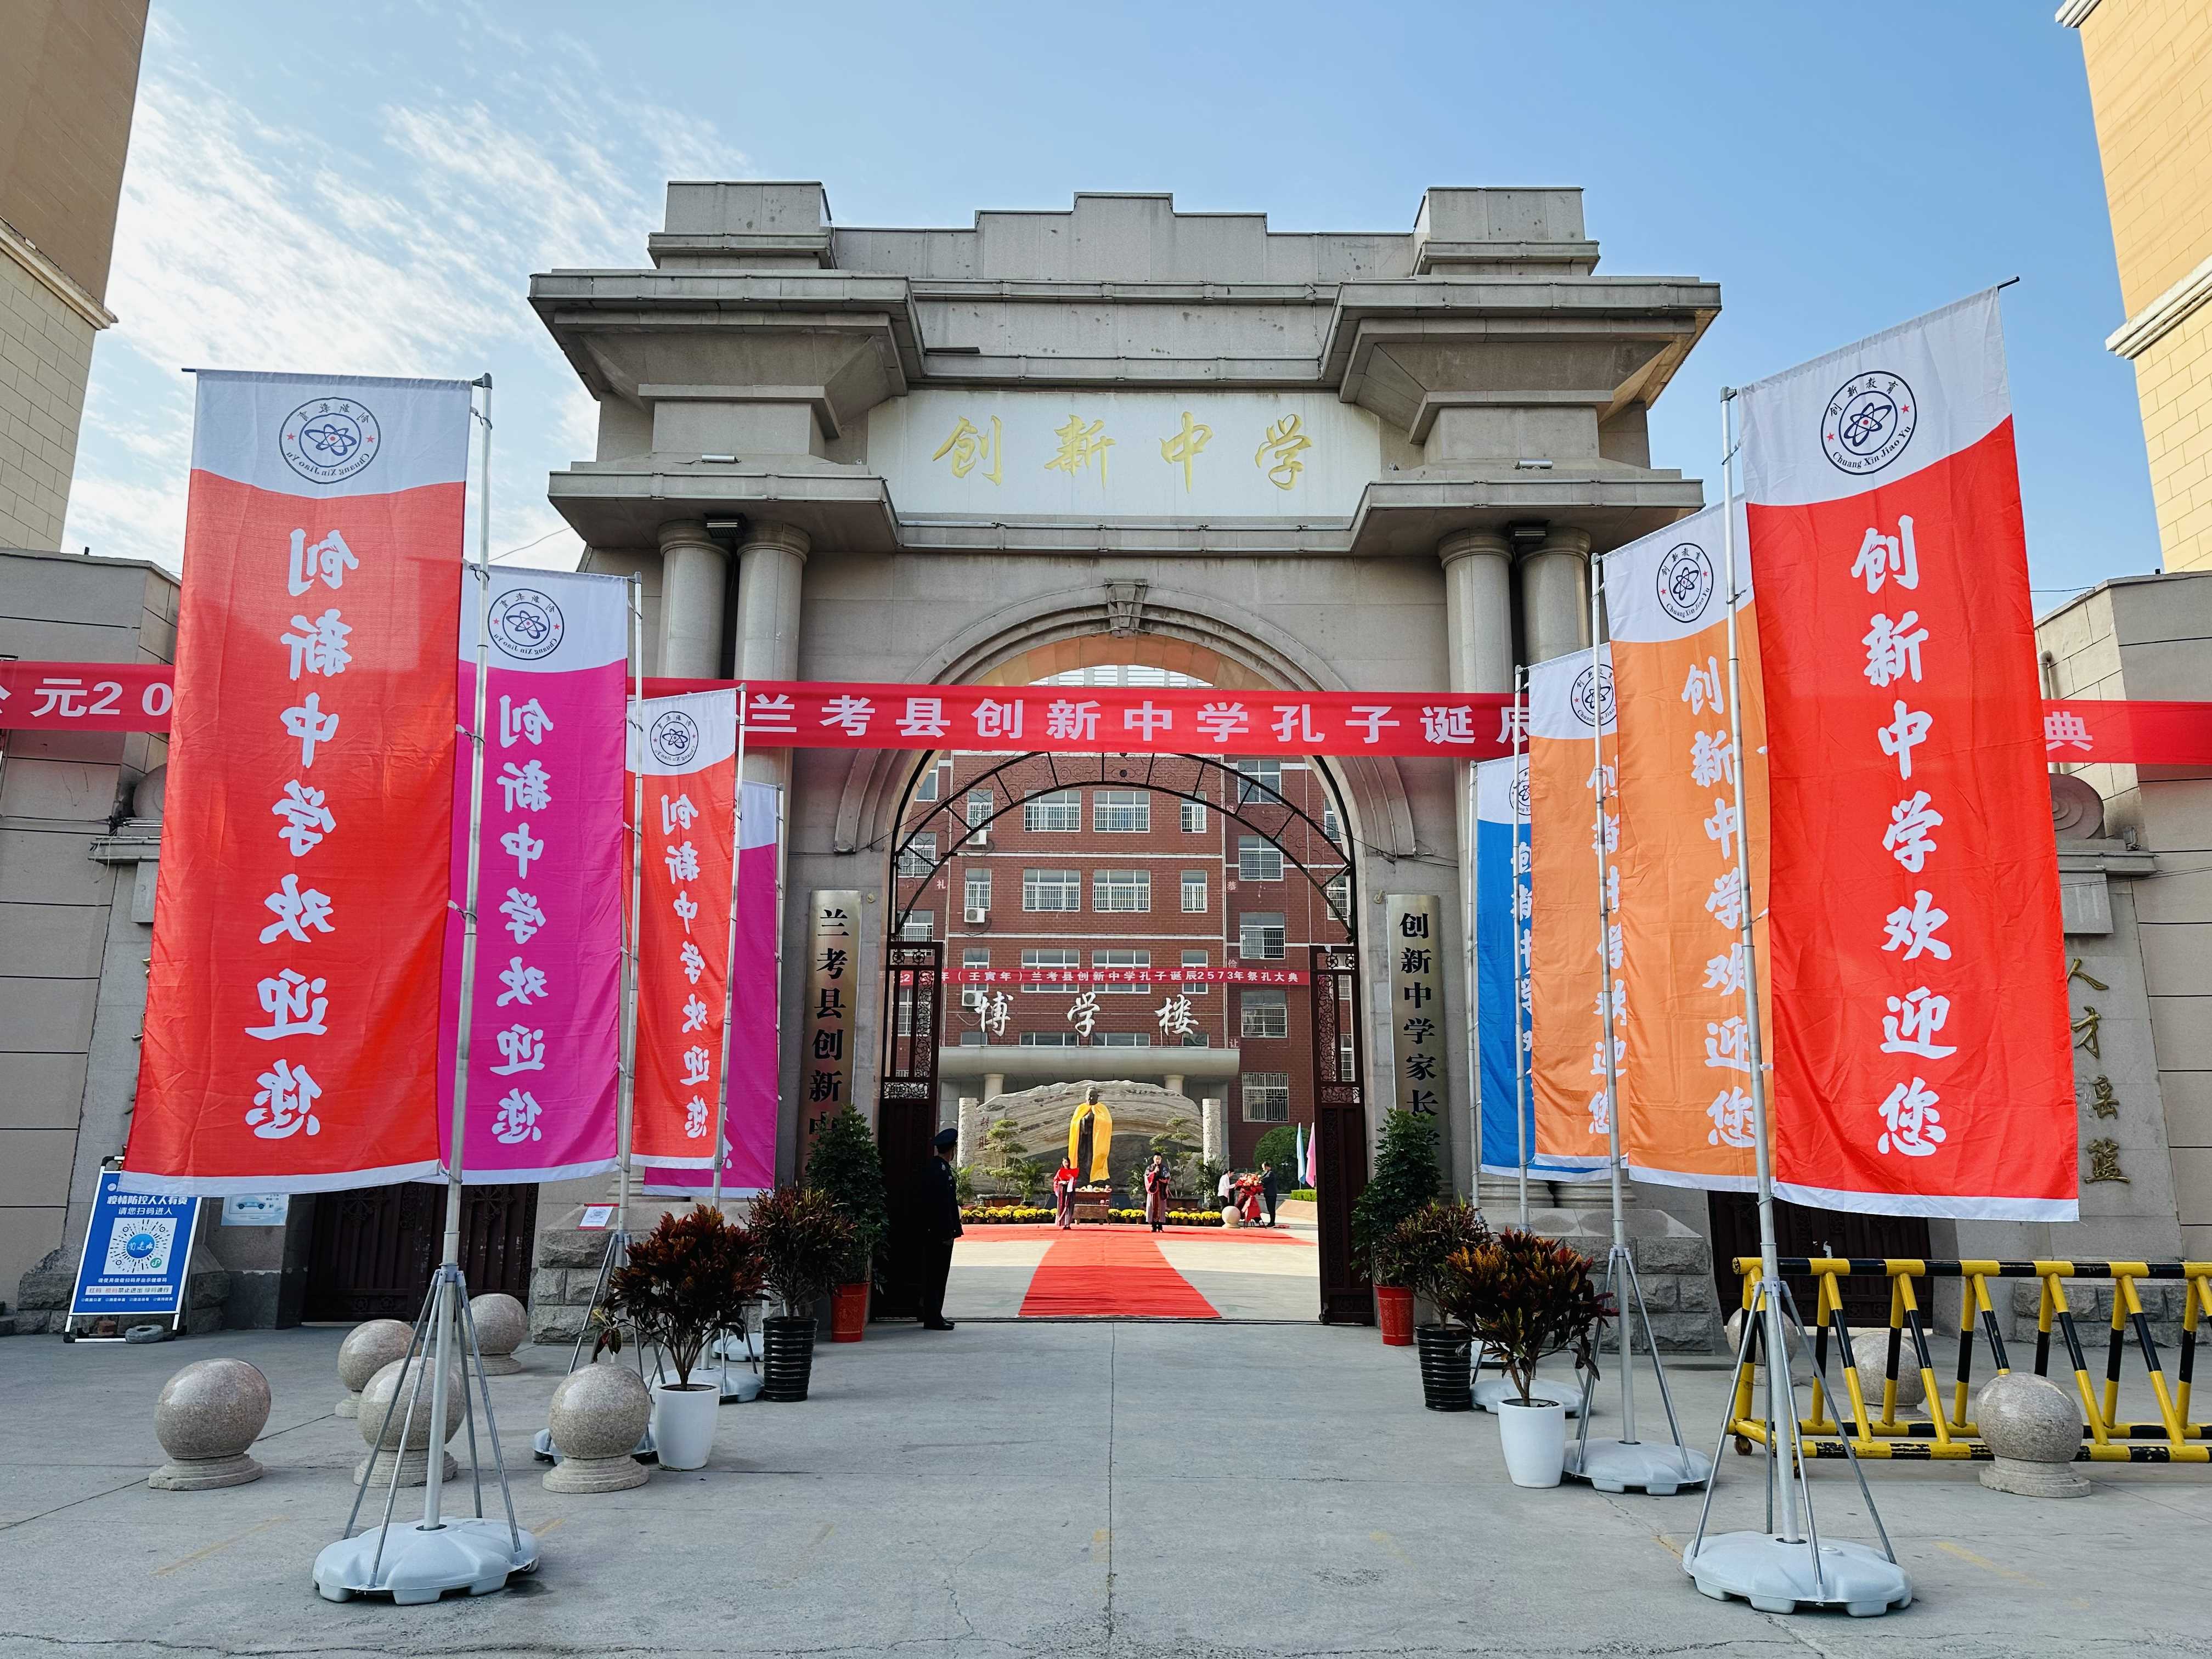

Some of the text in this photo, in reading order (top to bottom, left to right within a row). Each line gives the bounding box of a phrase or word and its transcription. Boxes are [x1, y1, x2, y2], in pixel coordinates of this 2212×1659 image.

[1830, 377, 1898, 417] 创新教育
[932, 410, 1312, 494] 创新中学
[1833, 426, 1911, 469] Chuang Xin Jiao Yu
[1666, 603, 1685, 618] Chuang
[2044, 711, 2094, 752] 典
[1850, 515, 1958, 1157] 创新中学欢迎您
[936, 879, 946, 889] 礼
[1681, 656, 1756, 1148] 创新中学欢迎您
[974, 991, 1200, 1037] 博学楼
[106, 1195, 188, 1205] 疫情防控人人有责
[118, 1206, 173, 1216] 请您扫码进入
